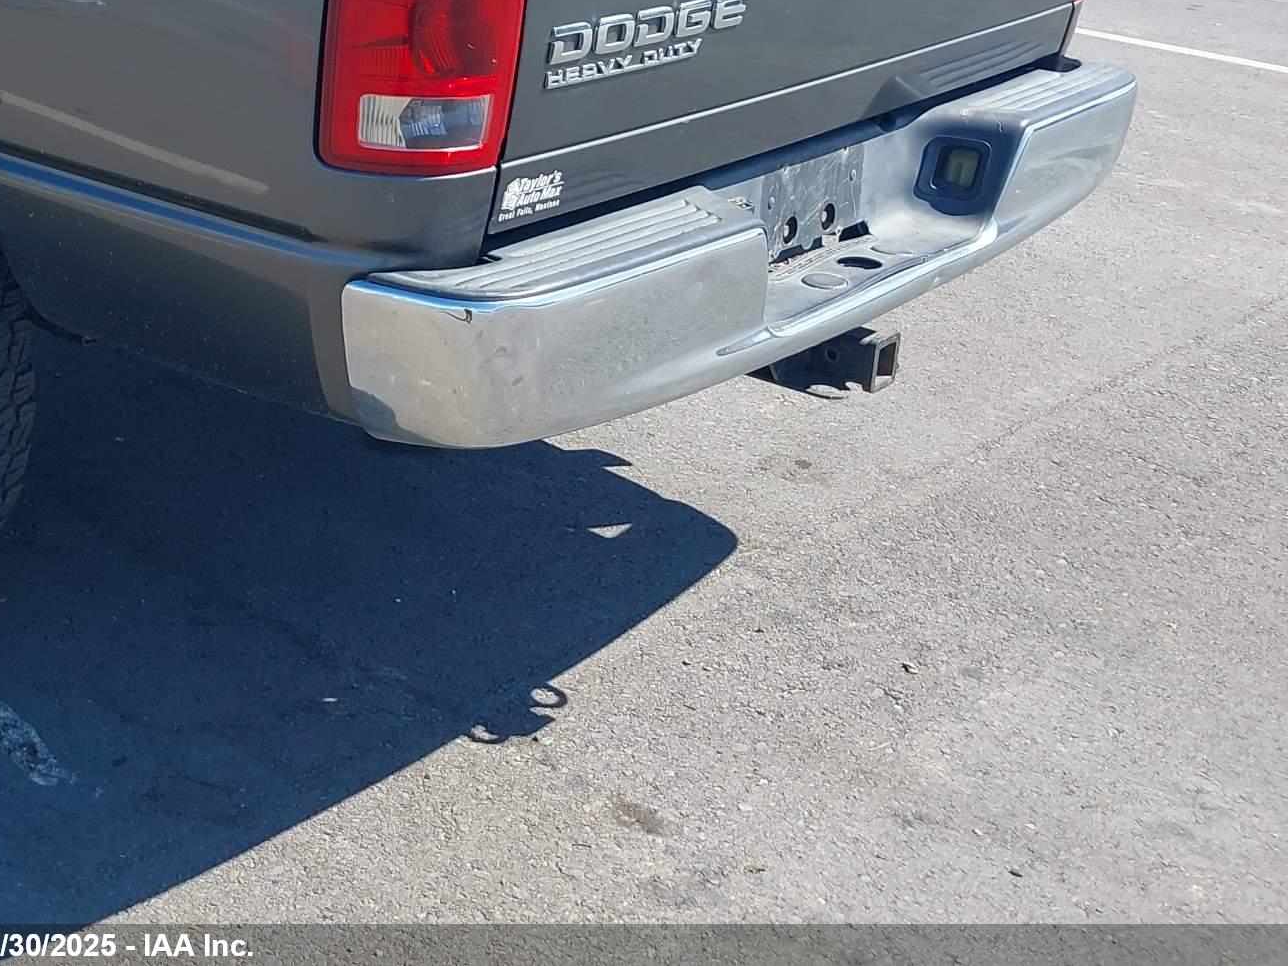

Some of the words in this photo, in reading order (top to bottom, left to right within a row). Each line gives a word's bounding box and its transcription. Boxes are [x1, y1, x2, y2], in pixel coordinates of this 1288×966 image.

[544, 54, 633, 90] HEAVY
[641, 37, 703, 67] DUTY
[519, 169, 563, 194] Taylor's
